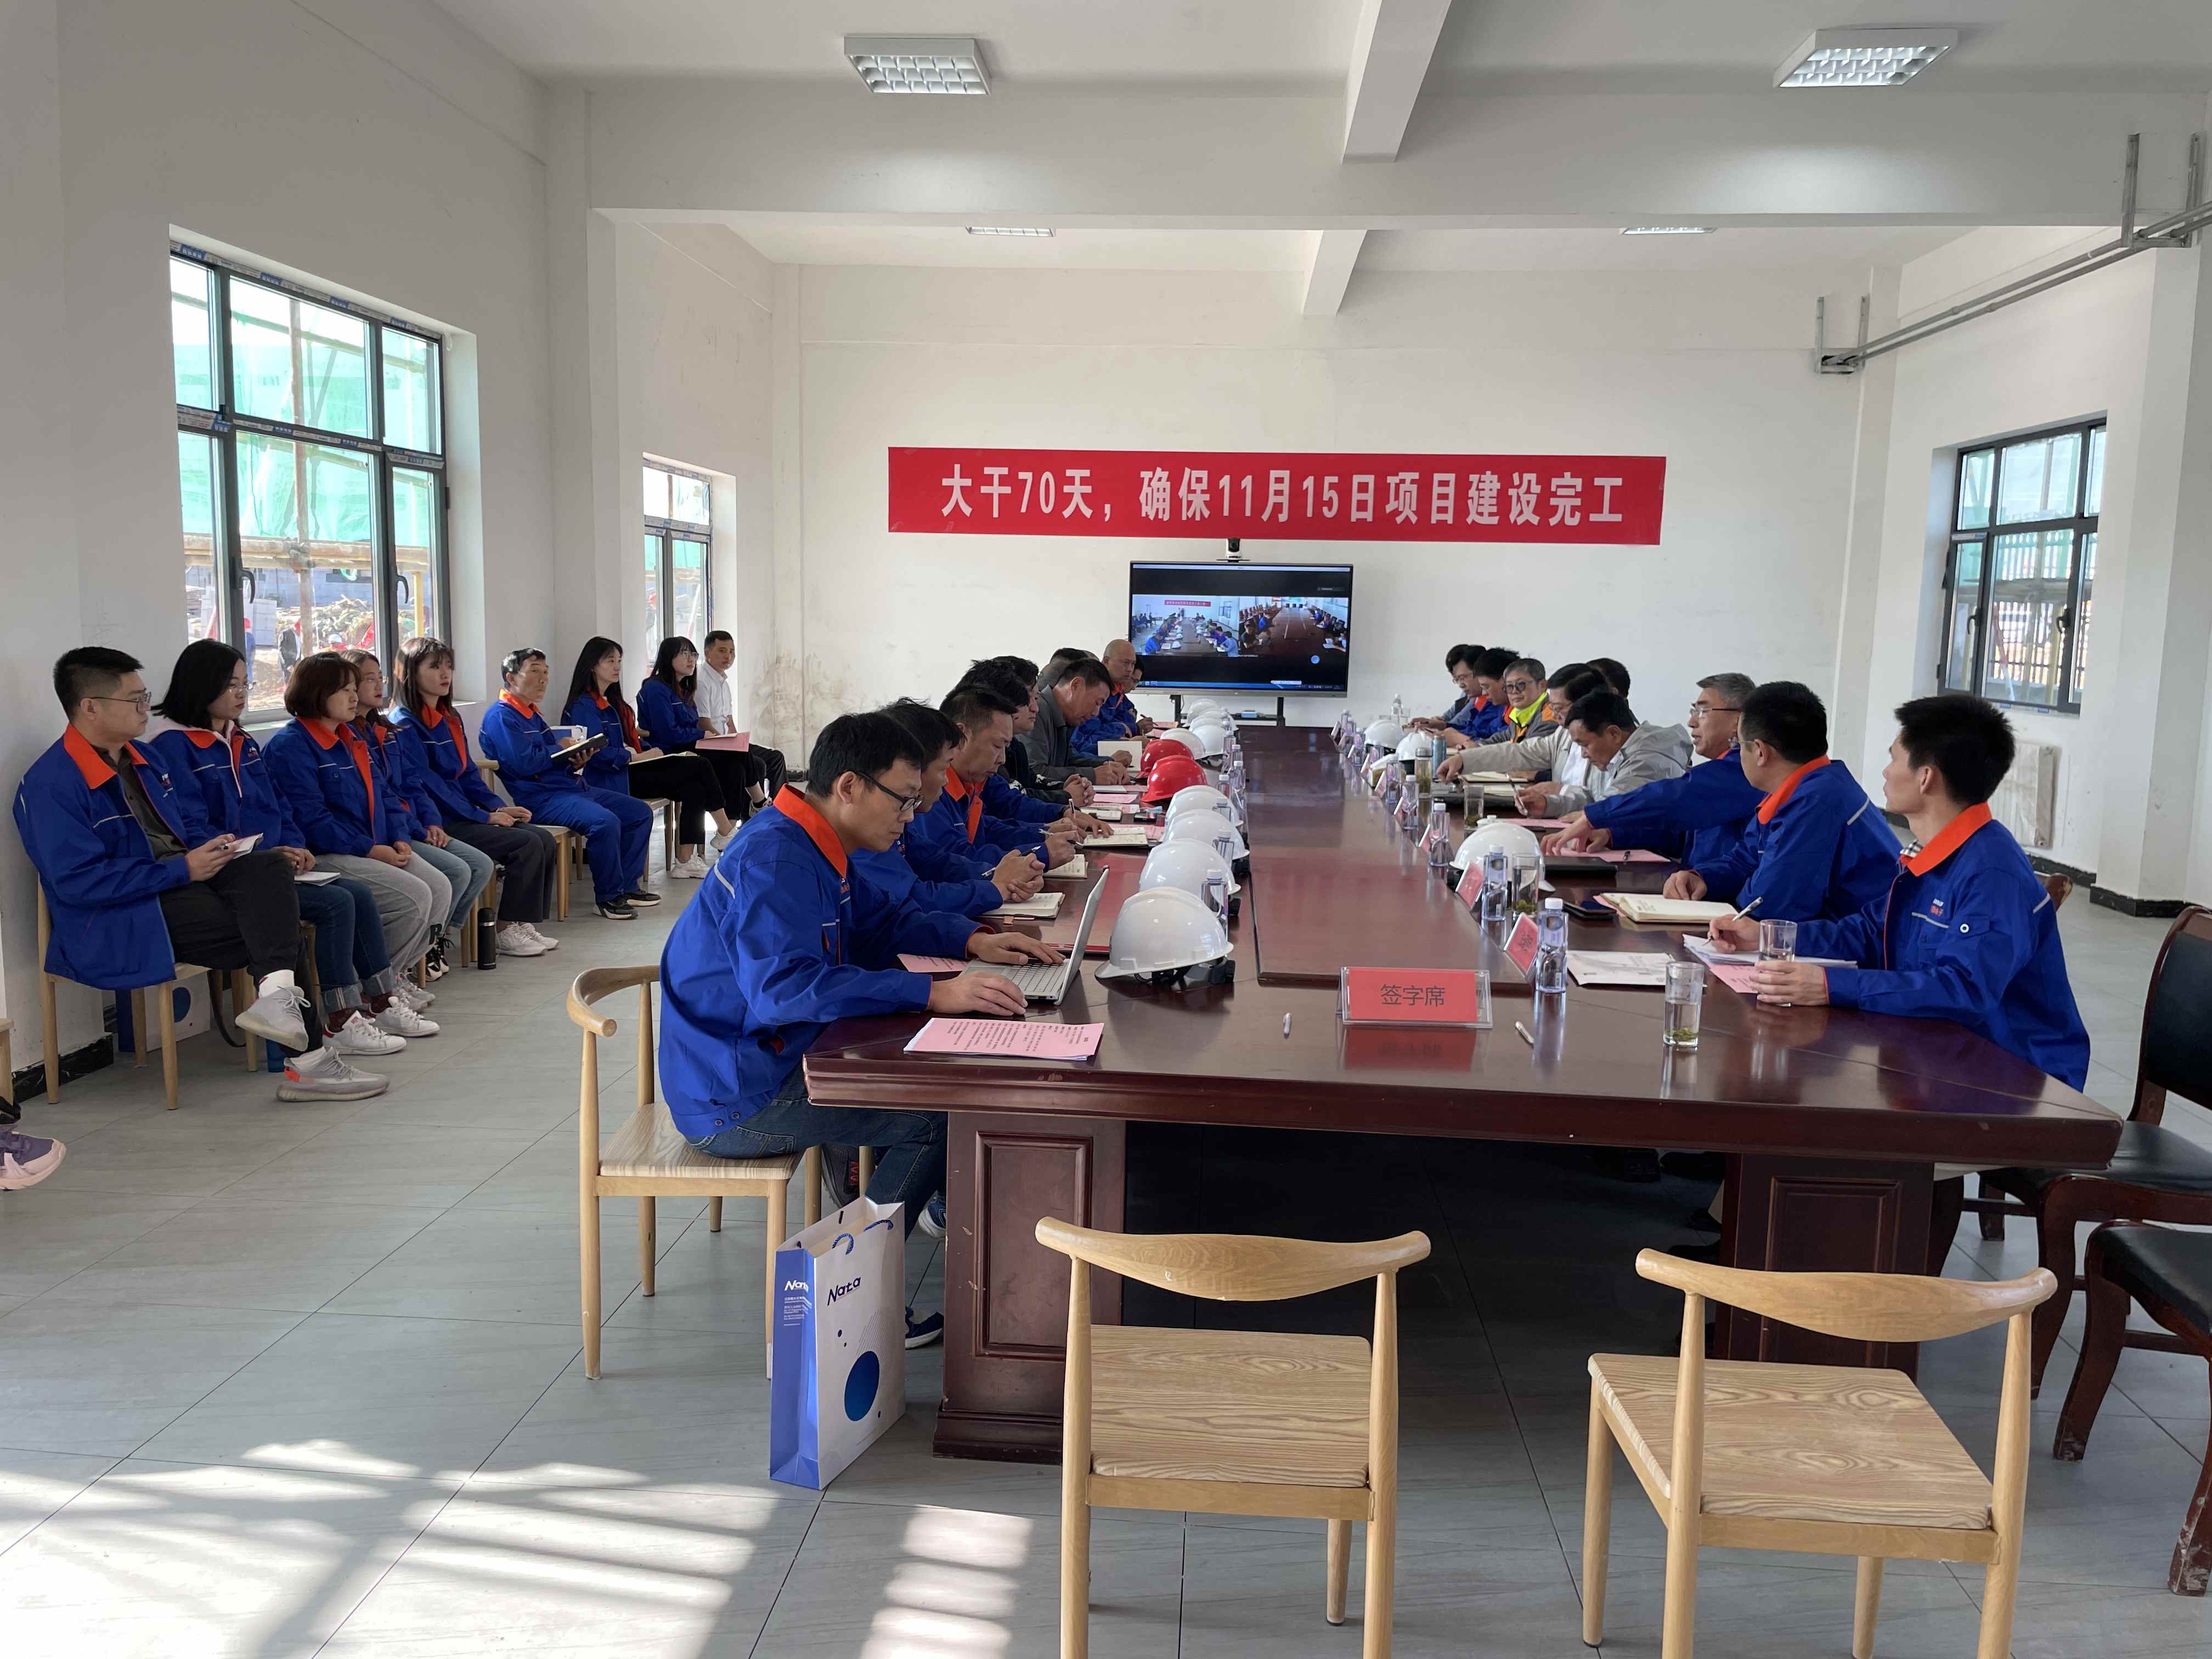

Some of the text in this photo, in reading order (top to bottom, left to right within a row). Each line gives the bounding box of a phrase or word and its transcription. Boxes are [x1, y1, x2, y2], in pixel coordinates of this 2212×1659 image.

[1380, 984, 1446, 1007] 签字席
[827, 1277, 861, 1306] Nata
